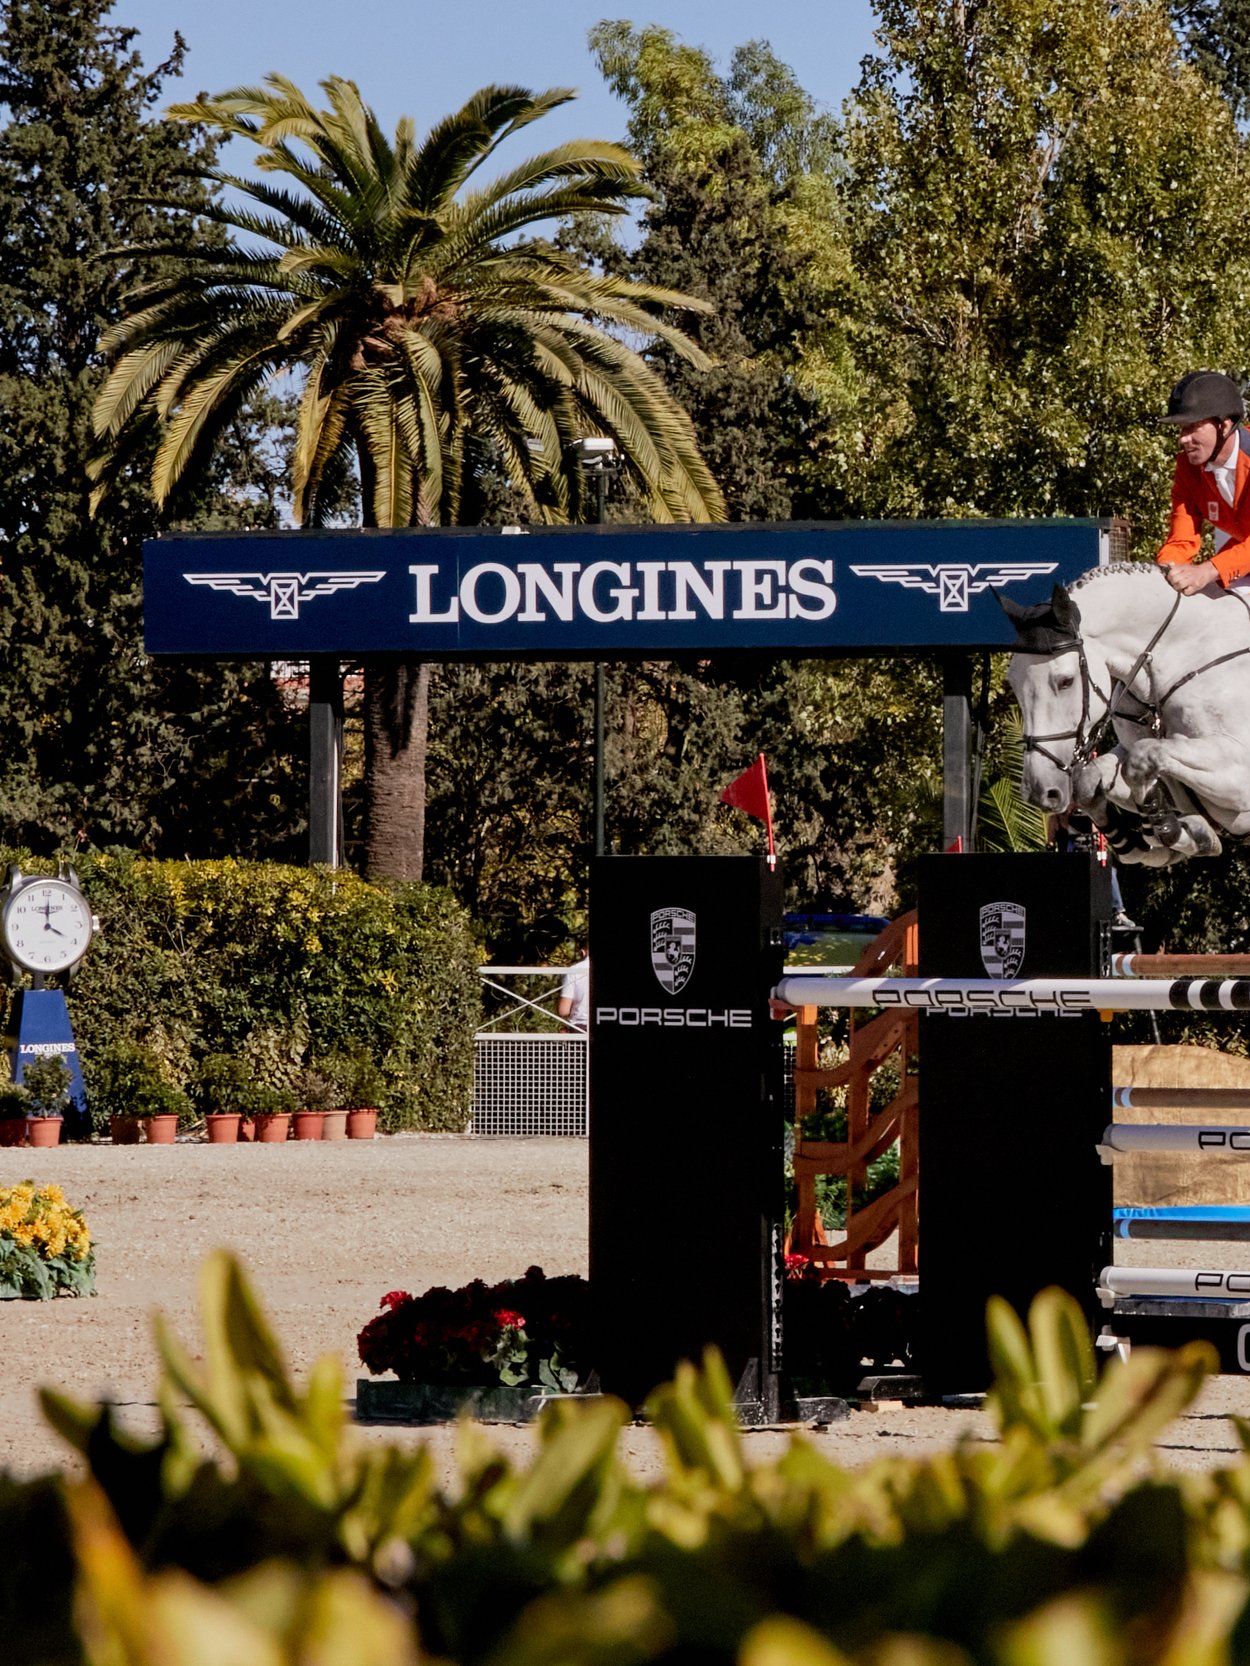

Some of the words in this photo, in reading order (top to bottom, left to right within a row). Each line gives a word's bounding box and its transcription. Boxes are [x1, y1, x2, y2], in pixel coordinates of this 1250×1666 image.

[408, 558, 837, 624] LONGINES
[31, 904, 63, 912] LONNES
[652, 907, 696, 923] PORSCHE
[872, 989, 1096, 1009] PORSCHE
[596, 1007, 752, 1027] PORSCHE
[20, 1043, 75, 1054] LONGINES
